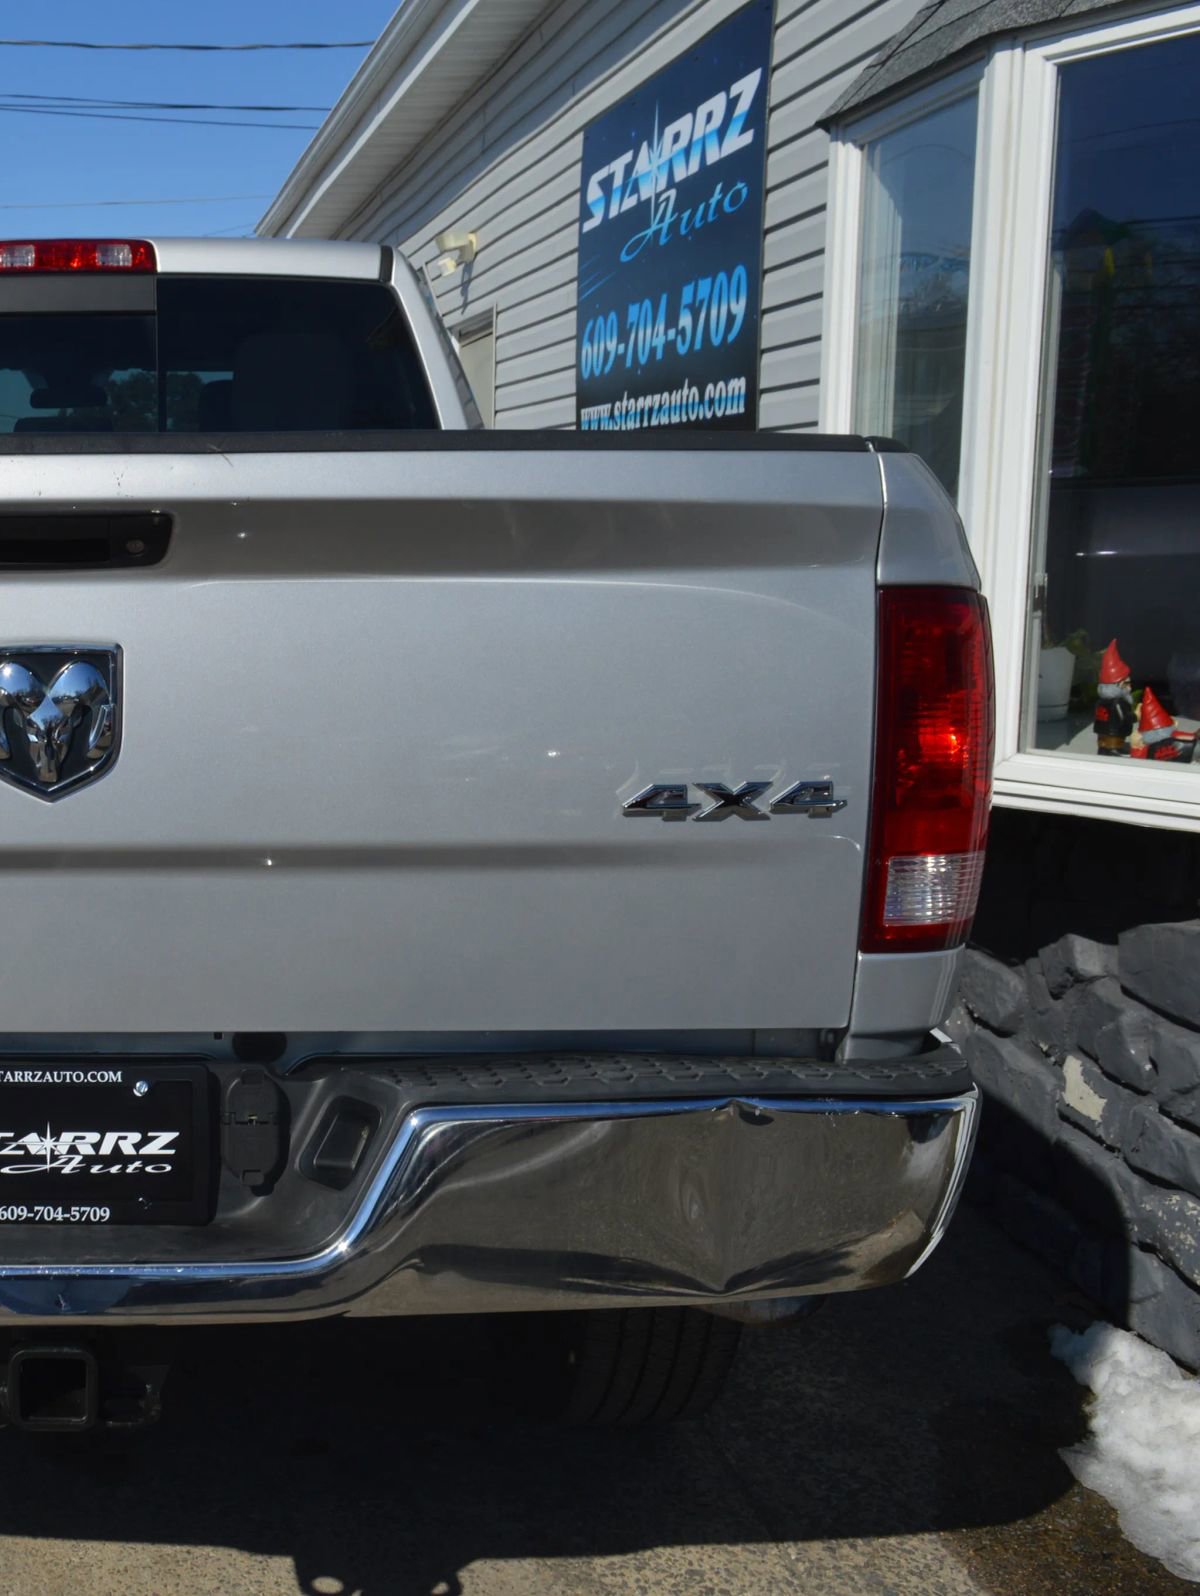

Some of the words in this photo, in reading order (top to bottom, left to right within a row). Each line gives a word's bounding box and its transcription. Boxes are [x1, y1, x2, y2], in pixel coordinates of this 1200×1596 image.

[582, 67, 762, 234] STARRZ
[619, 181, 749, 262] Auto
[581, 264, 748, 381] 609-704-5709
[580, 376, 747, 431] www.starrzauto.com
[0, 1154, 172, 1175] Auto
